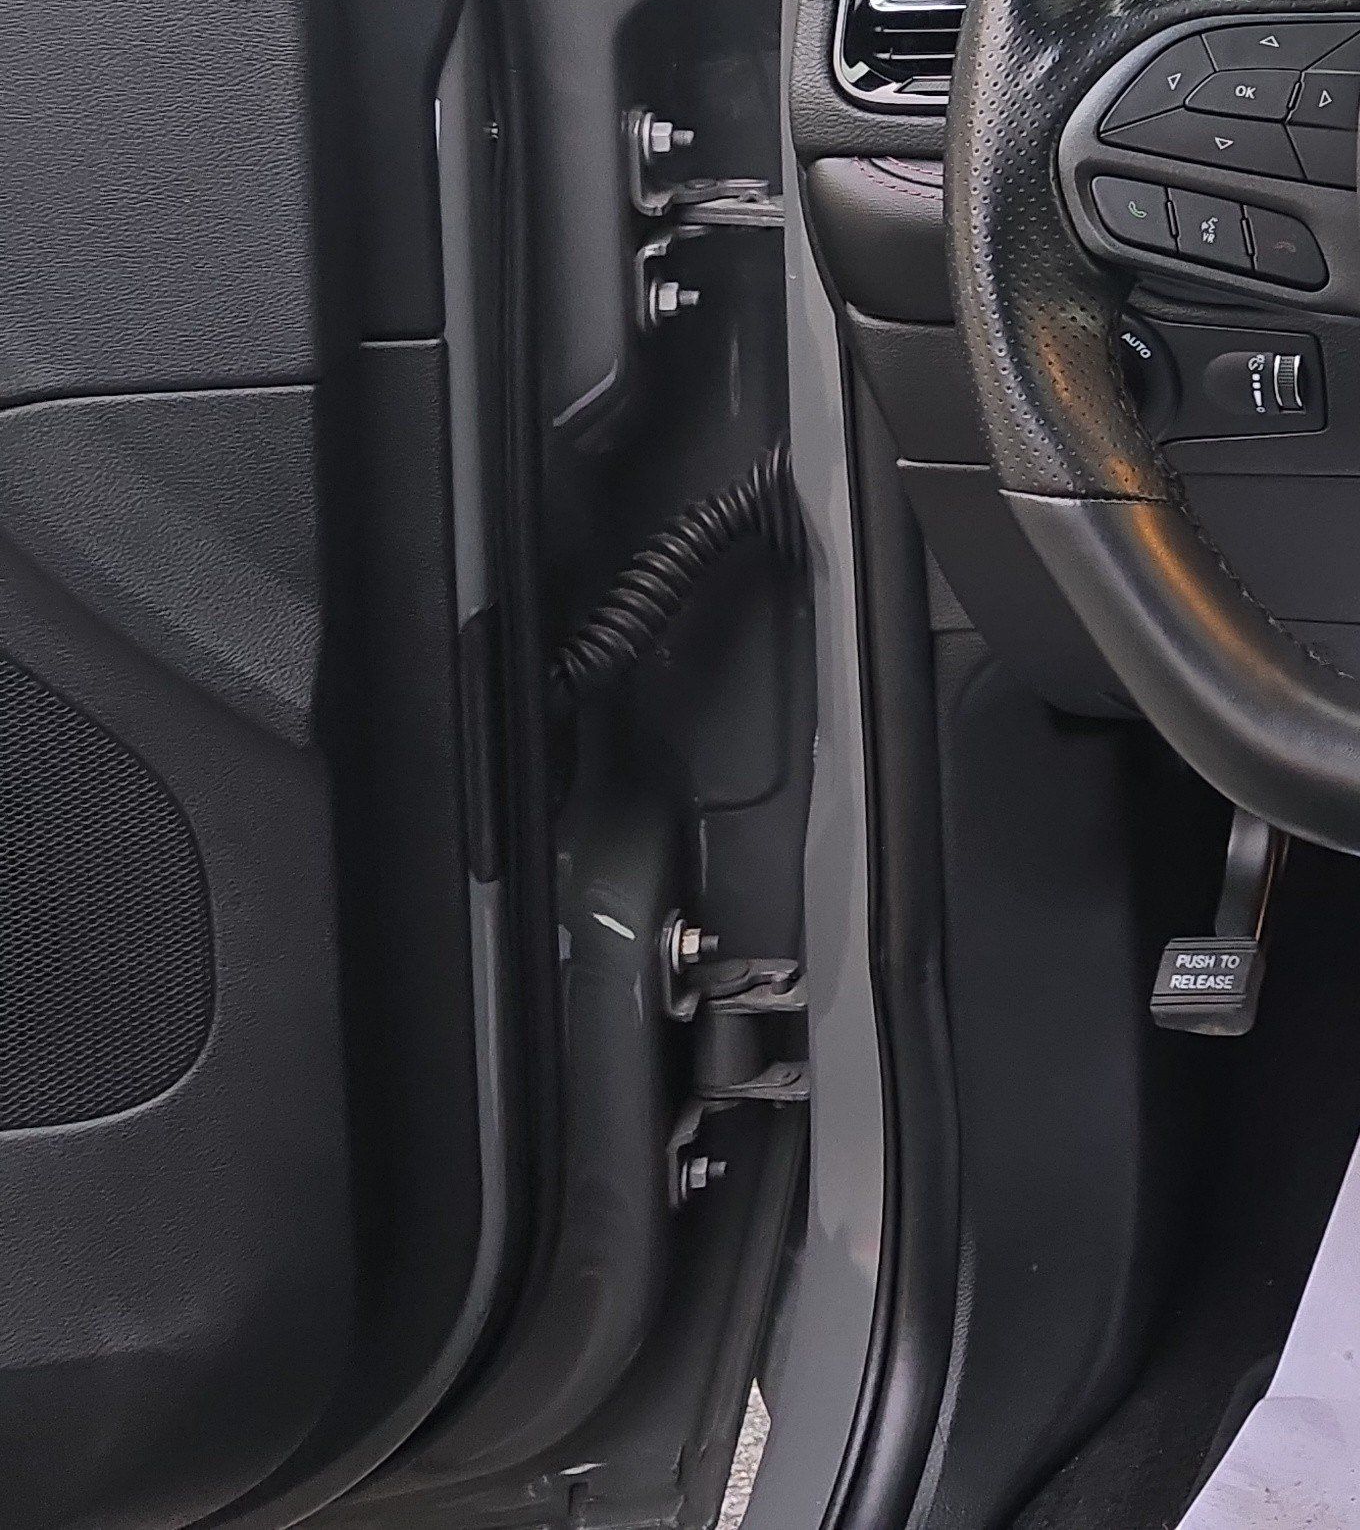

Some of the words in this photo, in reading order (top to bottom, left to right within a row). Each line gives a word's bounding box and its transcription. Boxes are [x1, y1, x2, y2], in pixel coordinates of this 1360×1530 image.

[1236, 85, 1256, 100] OK
[1121, 331, 1152, 360] AUTO
[1175, 953, 1216, 970] PUSH
[1220, 954, 1242, 970] TO
[1169, 974, 1236, 990] RELEASE
